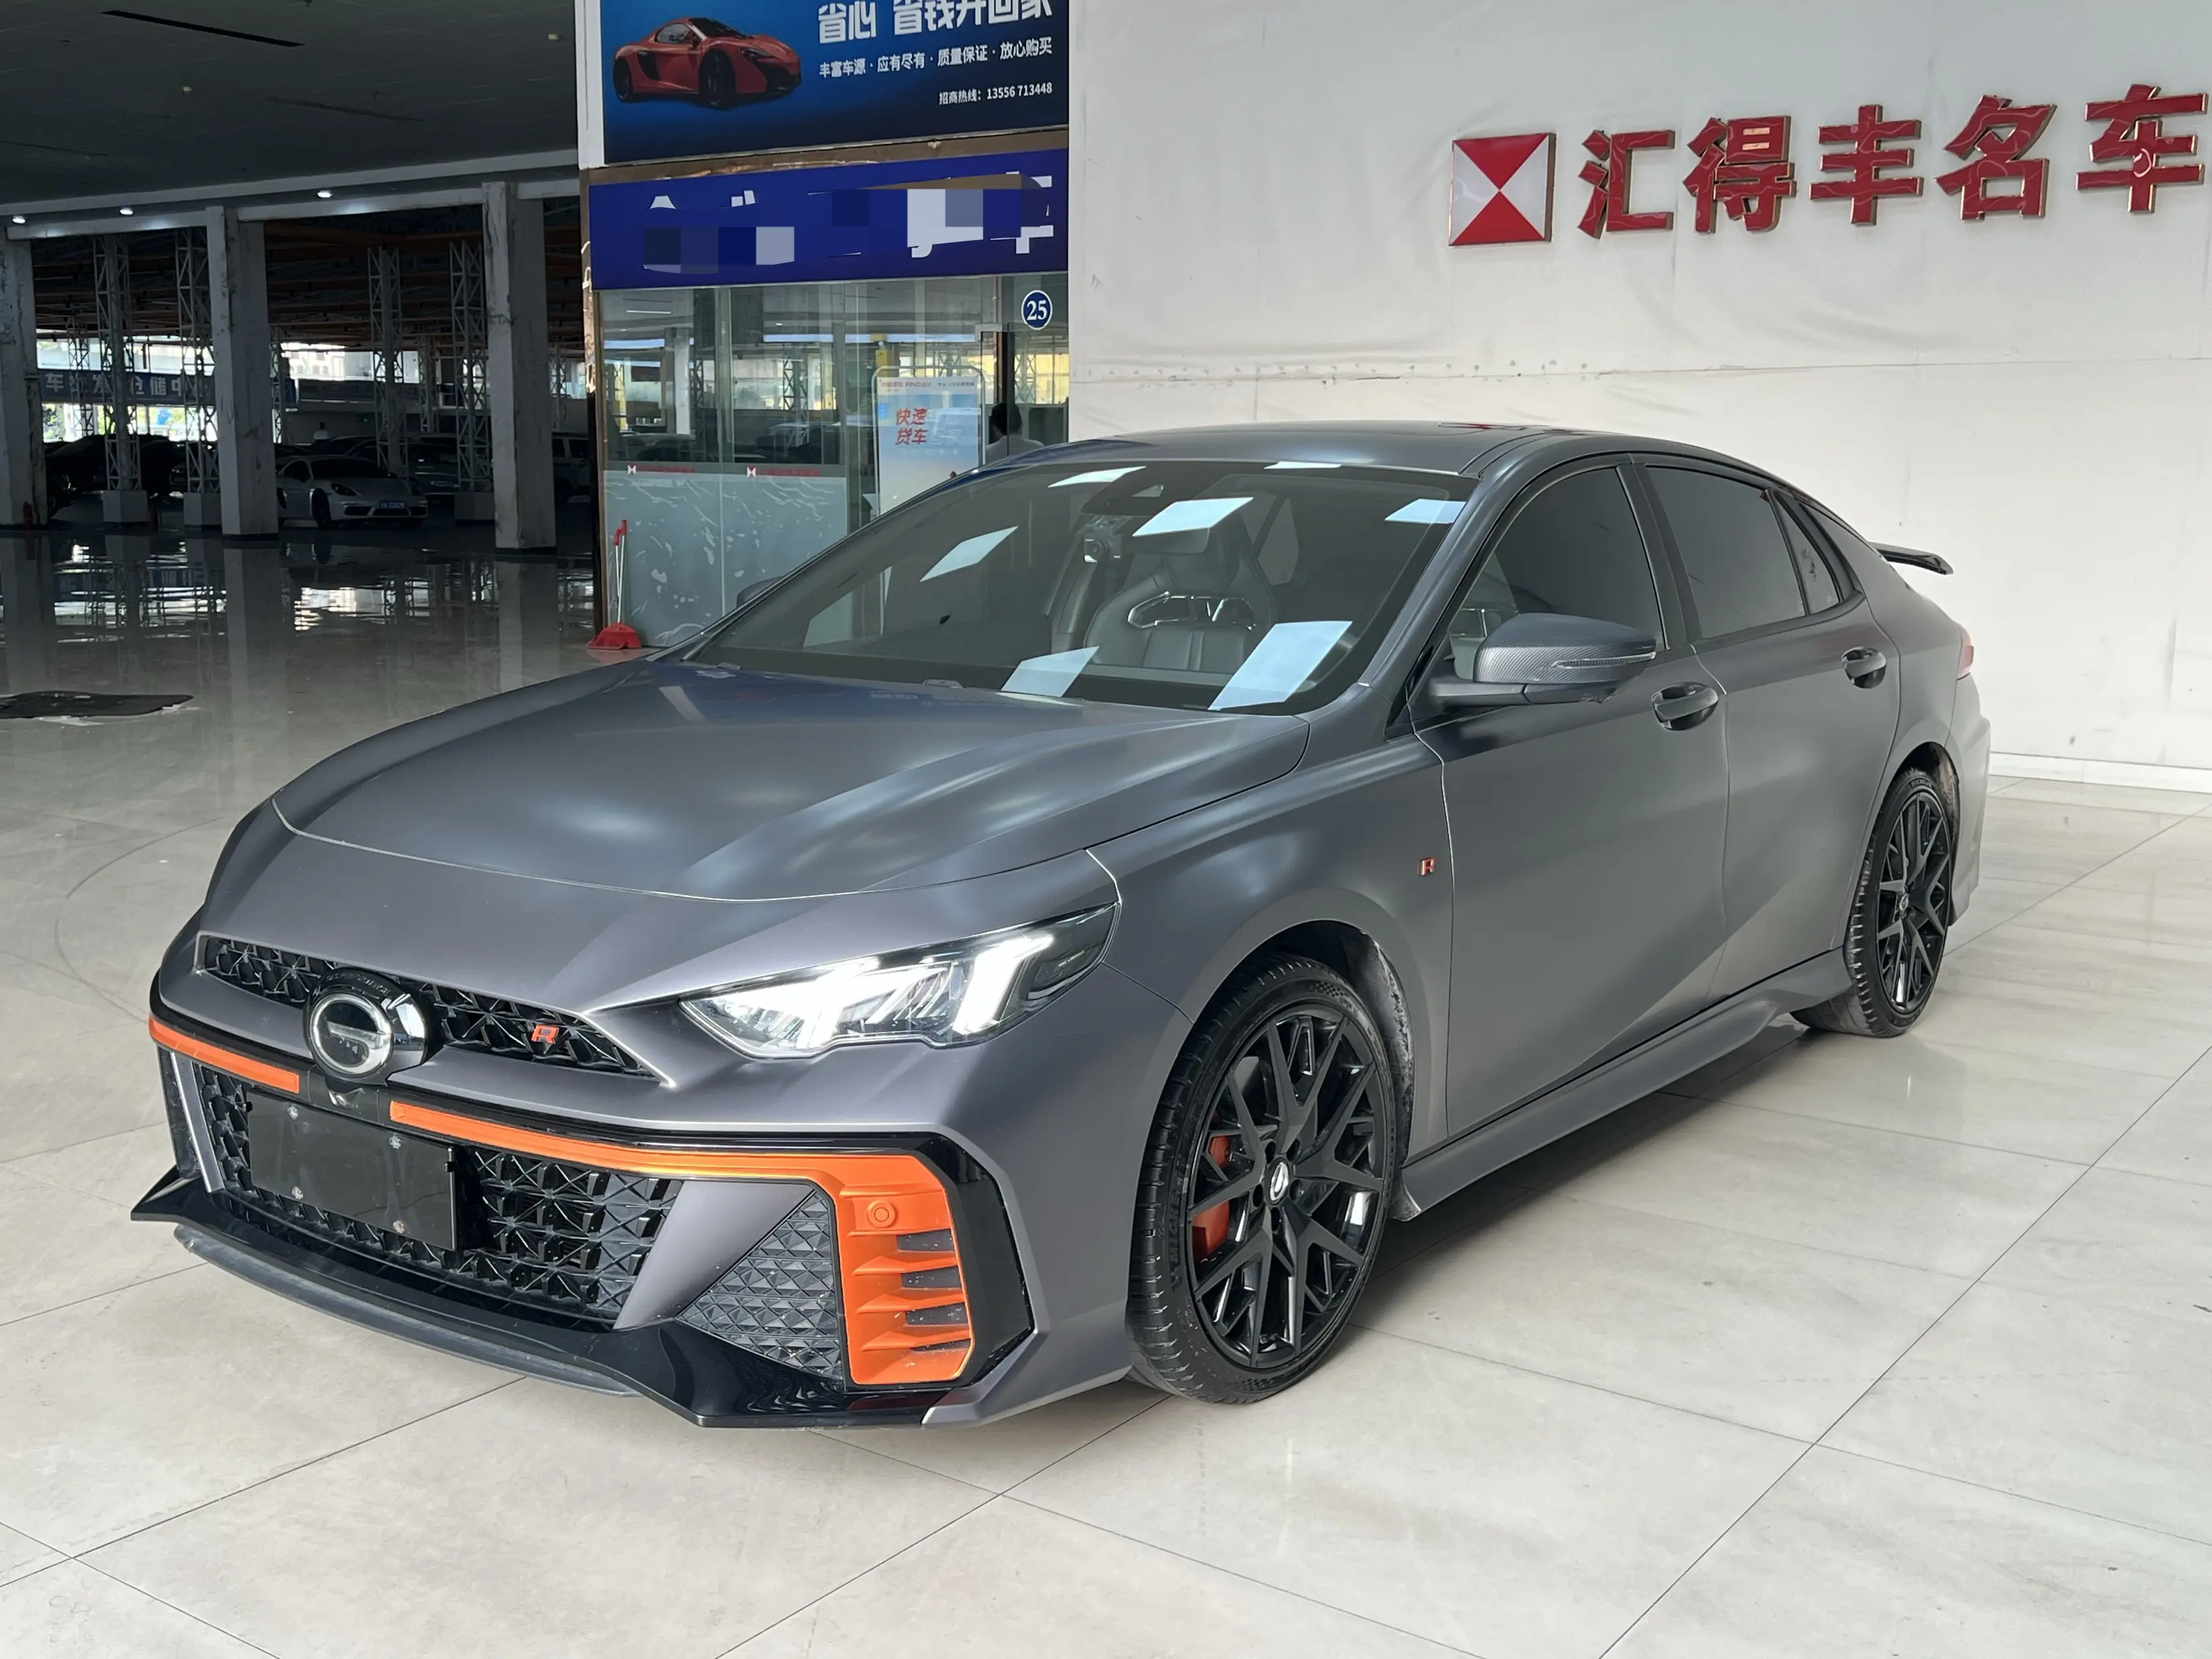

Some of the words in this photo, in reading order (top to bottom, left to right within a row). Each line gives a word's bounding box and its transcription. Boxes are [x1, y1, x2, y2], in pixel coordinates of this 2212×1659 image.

[818, 0, 878, 44] 省心
[1577, 83, 2210, 239] 汇得丰名车
[1026, 300, 1048, 321] 25
[1420, 857, 1435, 876] R
[531, 1025, 560, 1044] R
